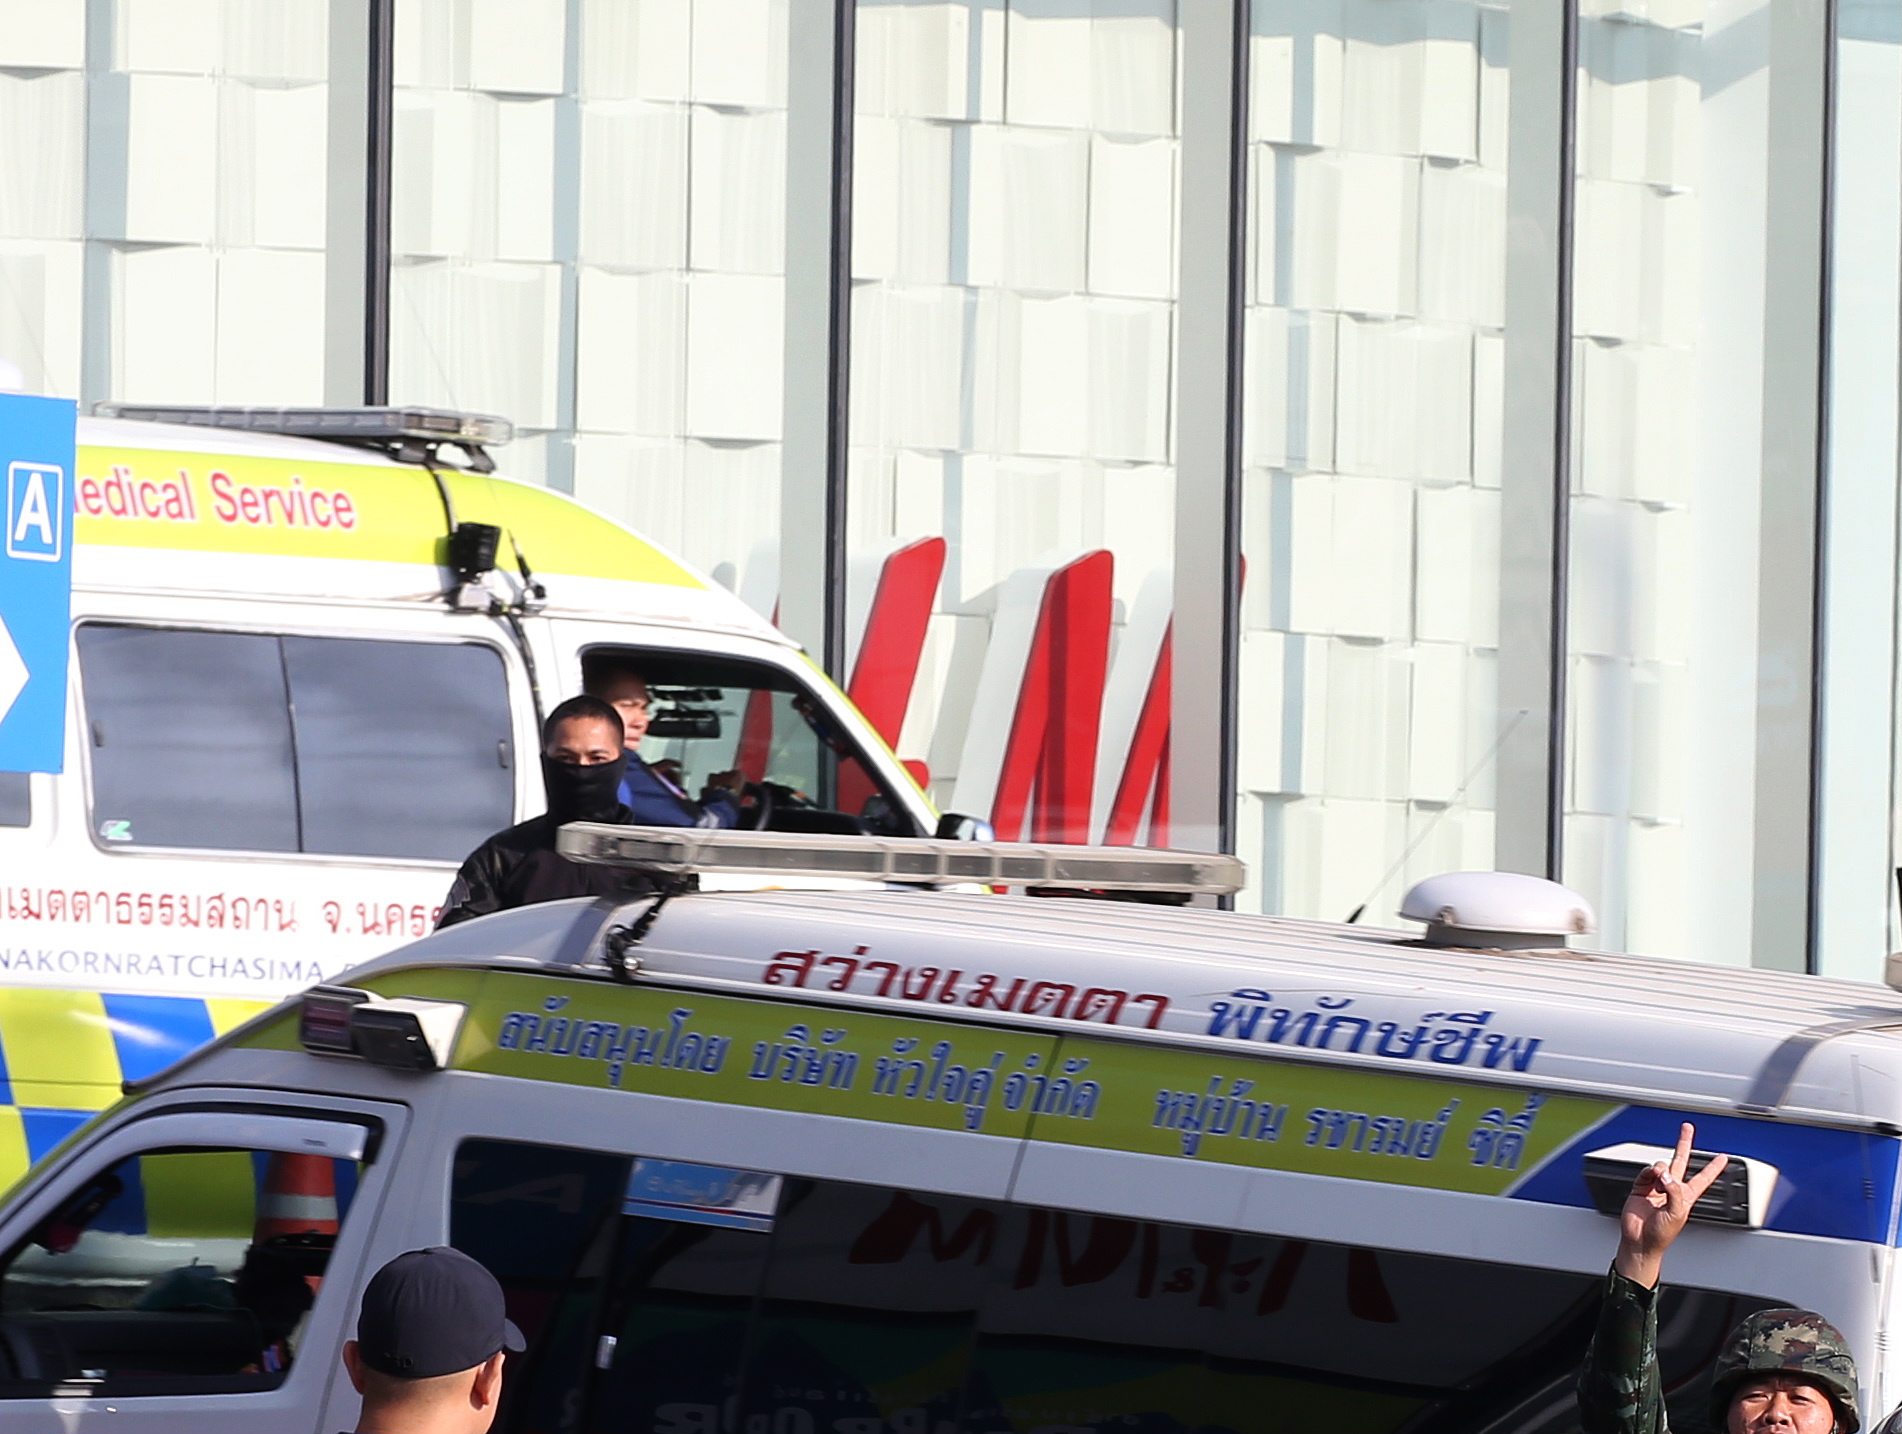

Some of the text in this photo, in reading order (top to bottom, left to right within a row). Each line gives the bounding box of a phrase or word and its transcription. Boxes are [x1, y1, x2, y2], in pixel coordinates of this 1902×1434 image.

[14, 472, 53, 544] A
[75, 467, 356, 530] edical Service
[0, 886, 299, 933] เมตตาธรรมสถาน
[763, 945, 1543, 1074] สว่างเมตตา พิทักษ์ชีพ
[500, 996, 732, 1088] สนับสนุนโดย
[748, 1024, 860, 1091] บริษัท
[871, 1037, 1006, 1131] หัวใจคู่
[1003, 1053, 1100, 1120] จำกัด
[1151, 1074, 1288, 1158] หมู่บ้าน
